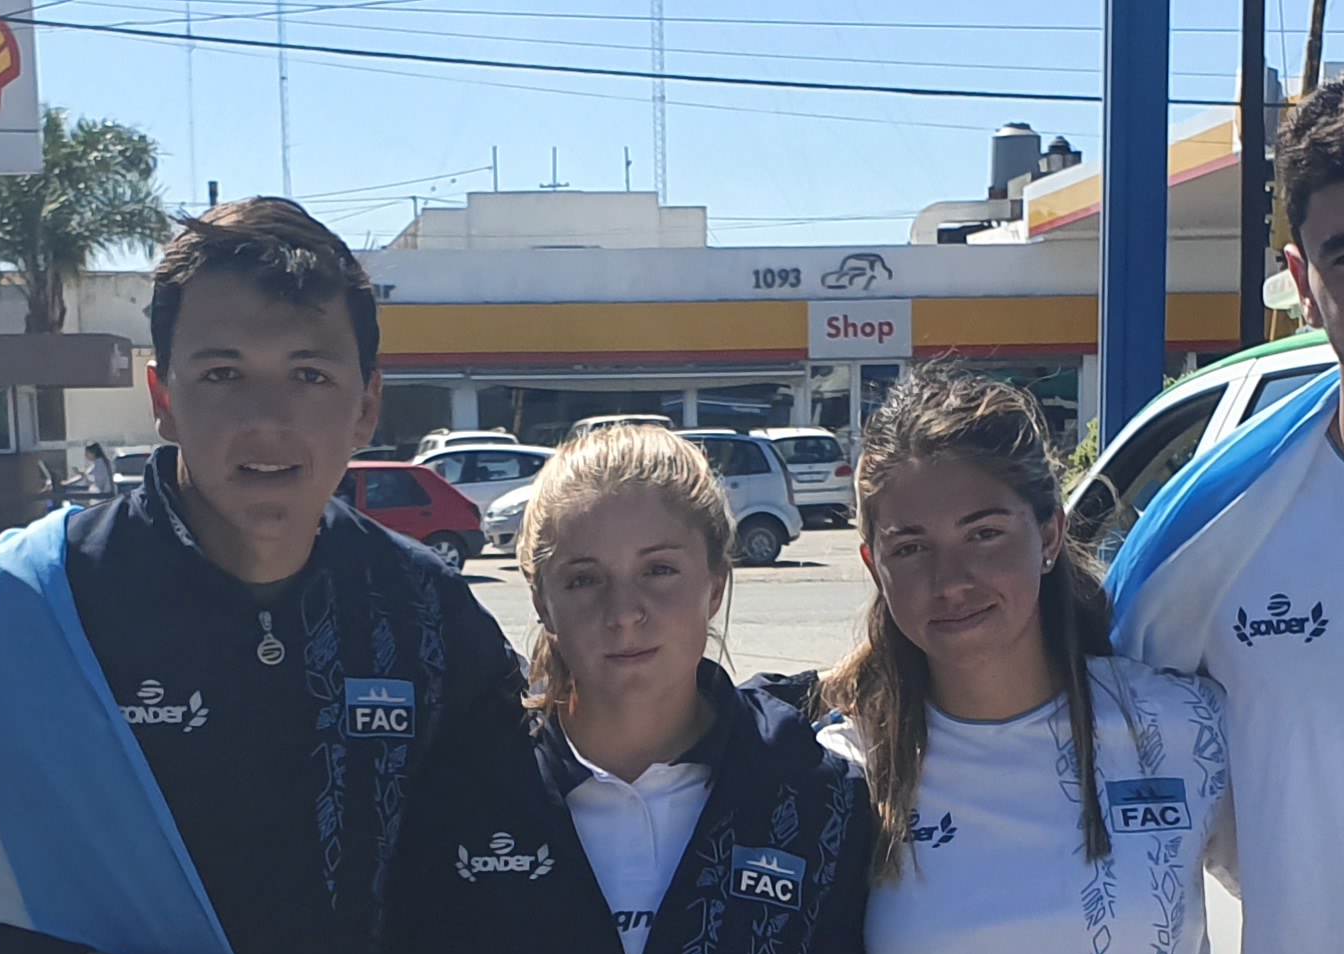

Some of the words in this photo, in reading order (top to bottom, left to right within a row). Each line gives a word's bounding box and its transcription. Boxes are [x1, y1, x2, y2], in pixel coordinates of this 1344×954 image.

[753, 268, 801, 289] 1093
[826, 314, 894, 344] Shop
[356, 707, 408, 732] FAC
[1121, 806, 1181, 827] FAC
[740, 870, 793, 902] FAC
